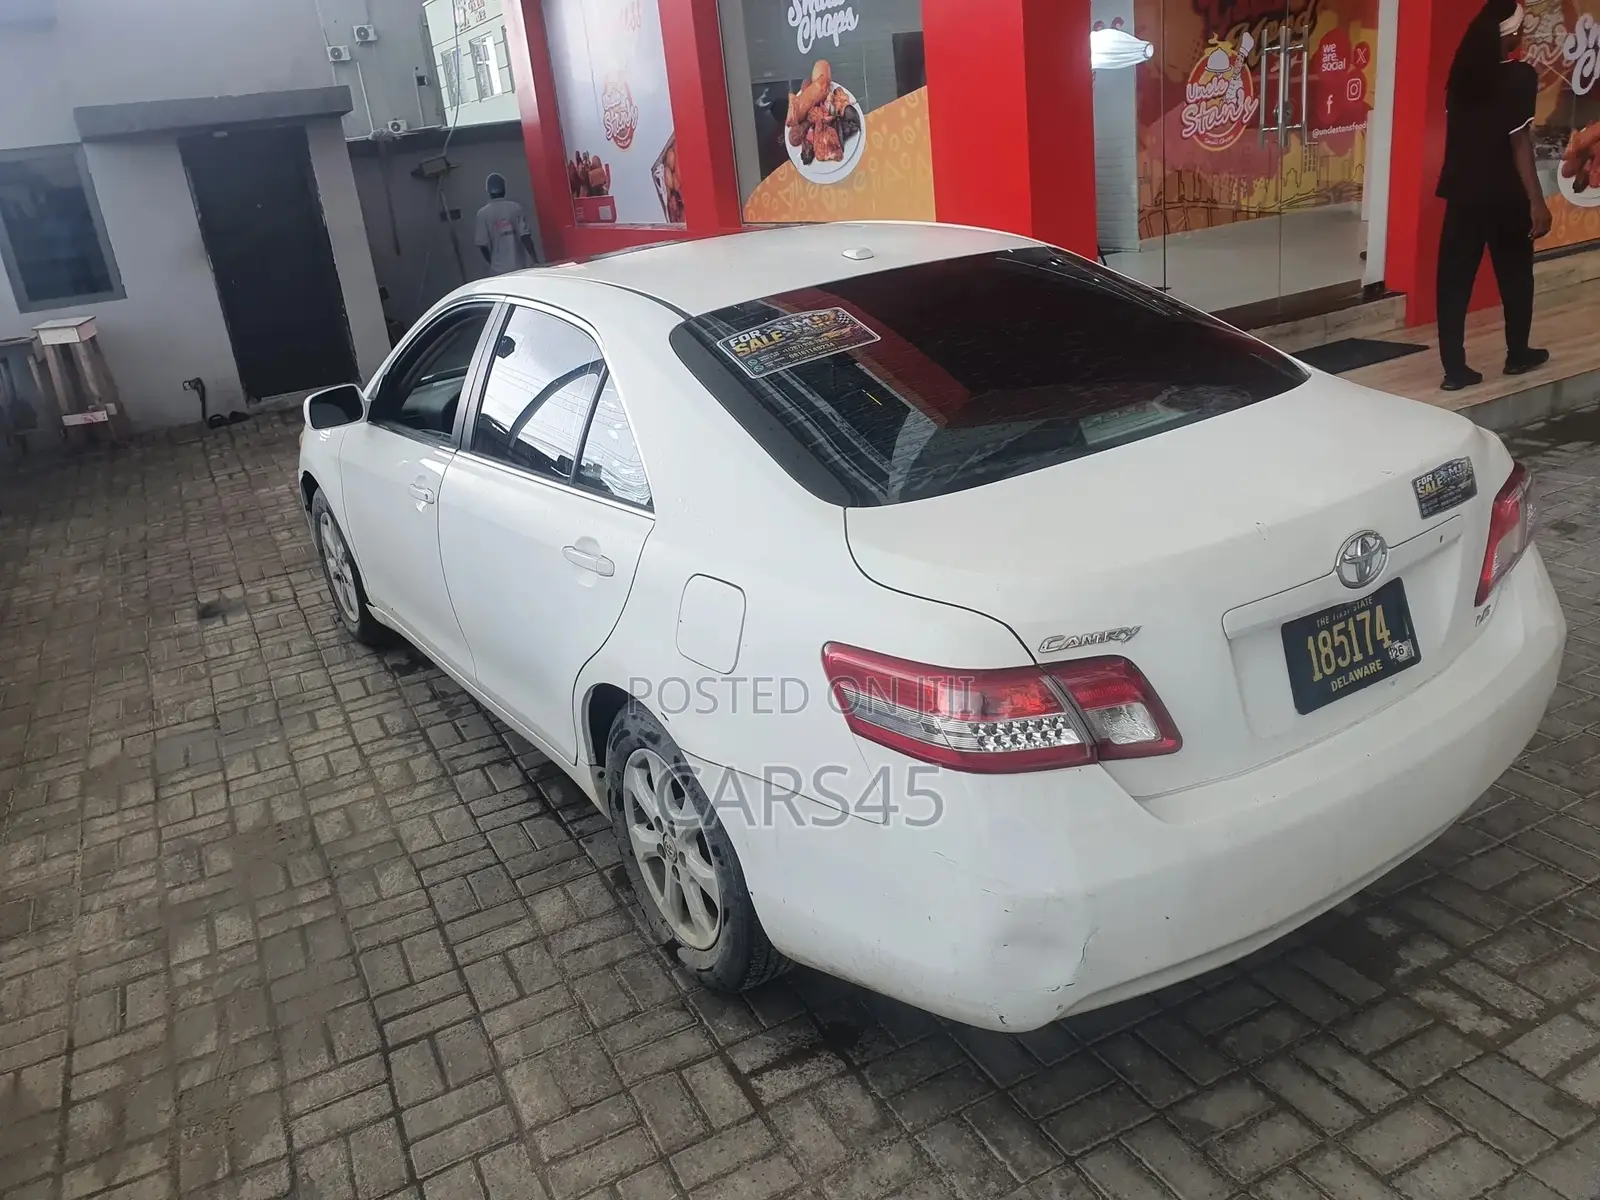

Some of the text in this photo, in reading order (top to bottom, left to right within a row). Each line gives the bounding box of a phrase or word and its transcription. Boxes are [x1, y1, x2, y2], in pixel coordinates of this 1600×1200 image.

[1322, 43, 1337, 53] we
[1321, 58, 1346, 72] social
[1186, 76, 1229, 103] Uncle
[1312, 121, 1368, 138] @unclestansfood
[728, 329, 761, 348] FOR
[733, 330, 785, 357] SALE
[1416, 474, 1433, 488] FOR
[1416, 477, 1443, 499] SALE
[1316, 615, 1330, 628] THE
[1038, 625, 1142, 654] CAMRY
[1307, 604, 1394, 683] 185174
[1331, 659, 1384, 692] DELAWARE
